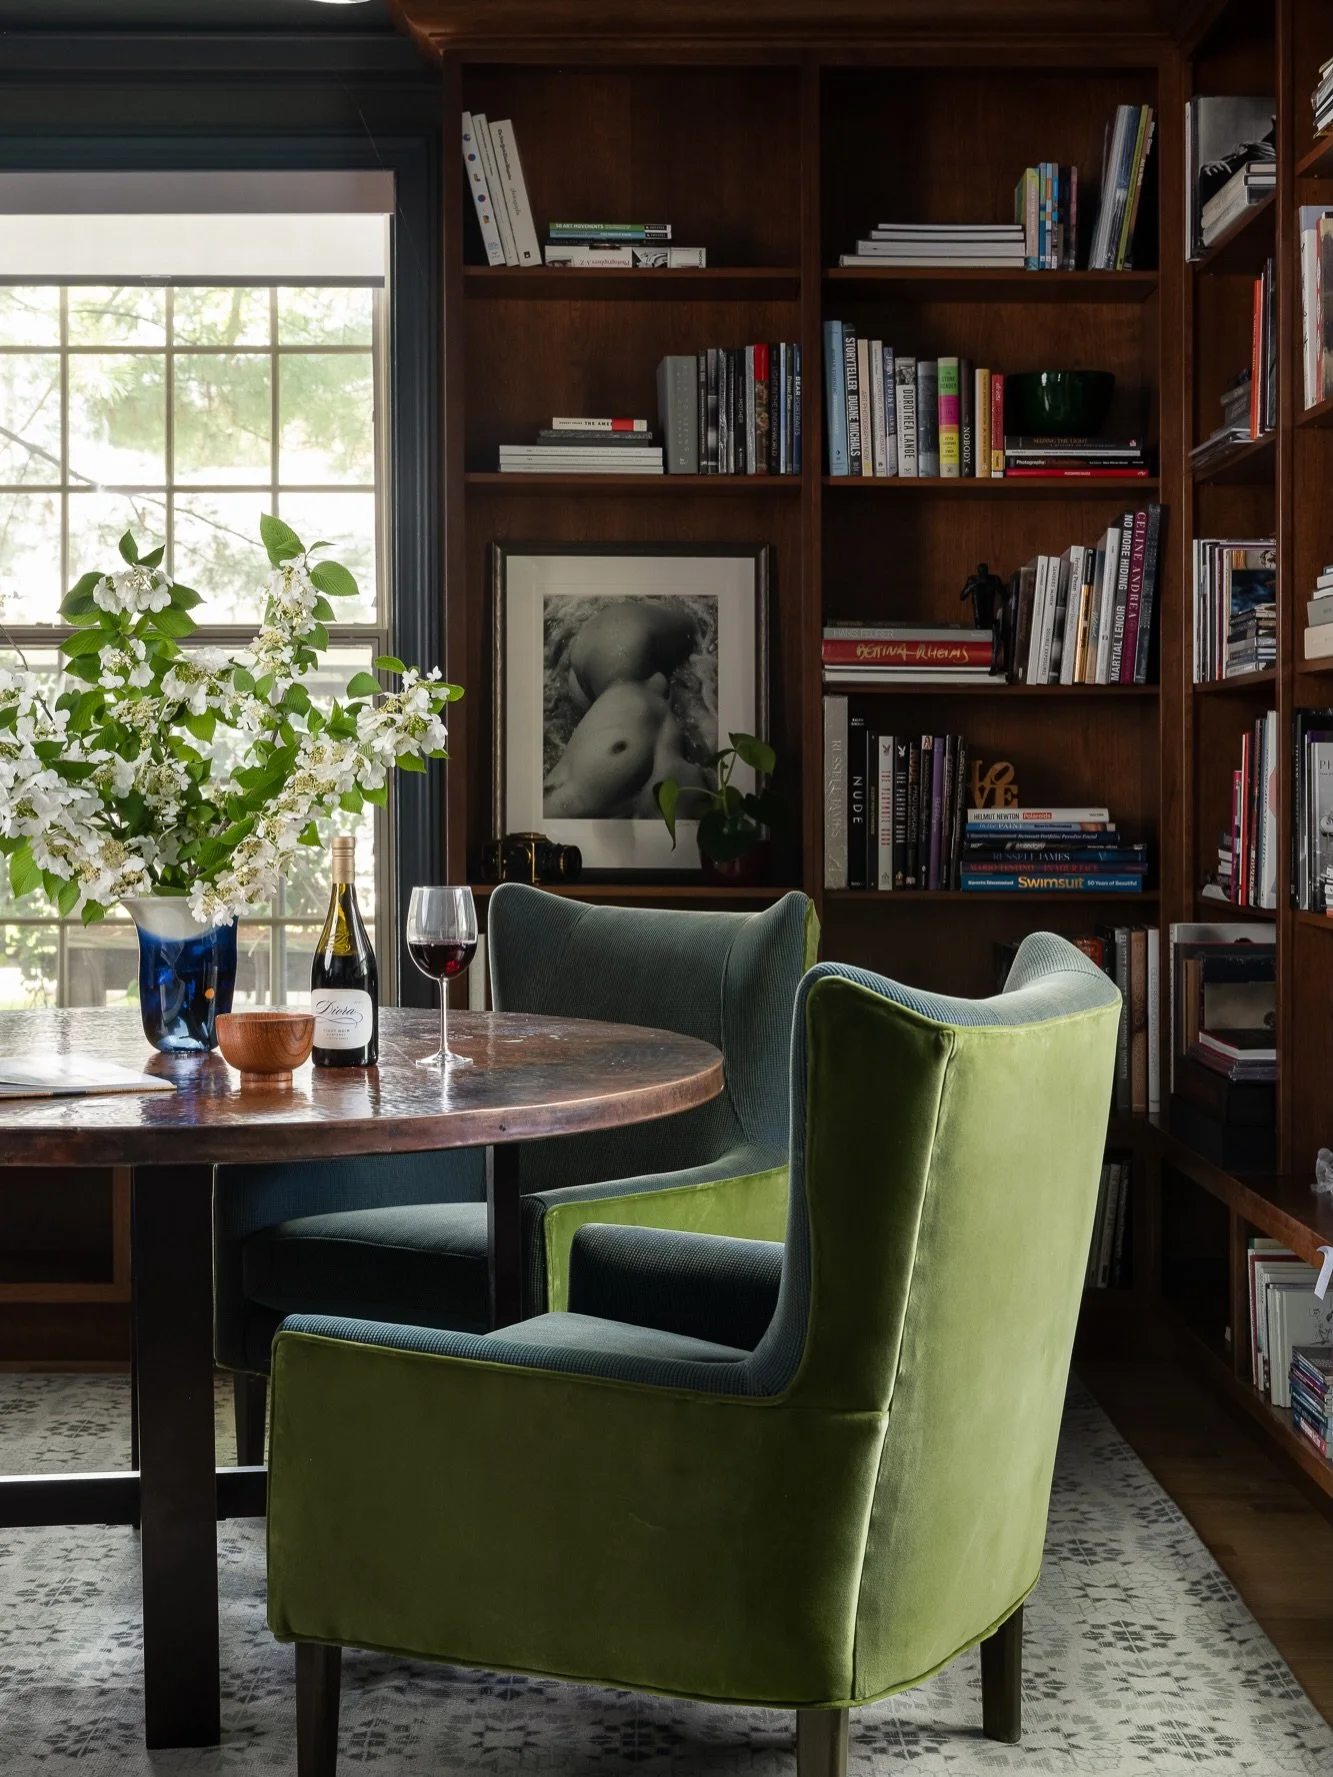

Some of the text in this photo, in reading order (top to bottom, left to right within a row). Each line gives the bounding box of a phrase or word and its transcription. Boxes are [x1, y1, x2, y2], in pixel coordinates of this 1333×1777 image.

[845, 337, 861, 456] STORYTELLER DUANE MICHALS
[903, 389, 915, 459] DOROTHEA LANGE
[963, 427, 971, 464] NOBODY
[1072, 557, 1080, 575] Irving
[1118, 514, 1133, 591] NO MORE HIDING
[1128, 511, 1147, 619] CELINE ANDREA
[856, 643, 969, 664] BETTINA RHEIMS
[1110, 605, 1126, 682] MARTIAL LENOIR
[831, 740, 843, 838] RUSSELL JAMES
[852, 776, 863, 824] NUDE
[1038, 852, 1070, 861] JAMES
[1018, 875, 1084, 890] Swimsuit
[316, 1000, 361, 1018] Diora
